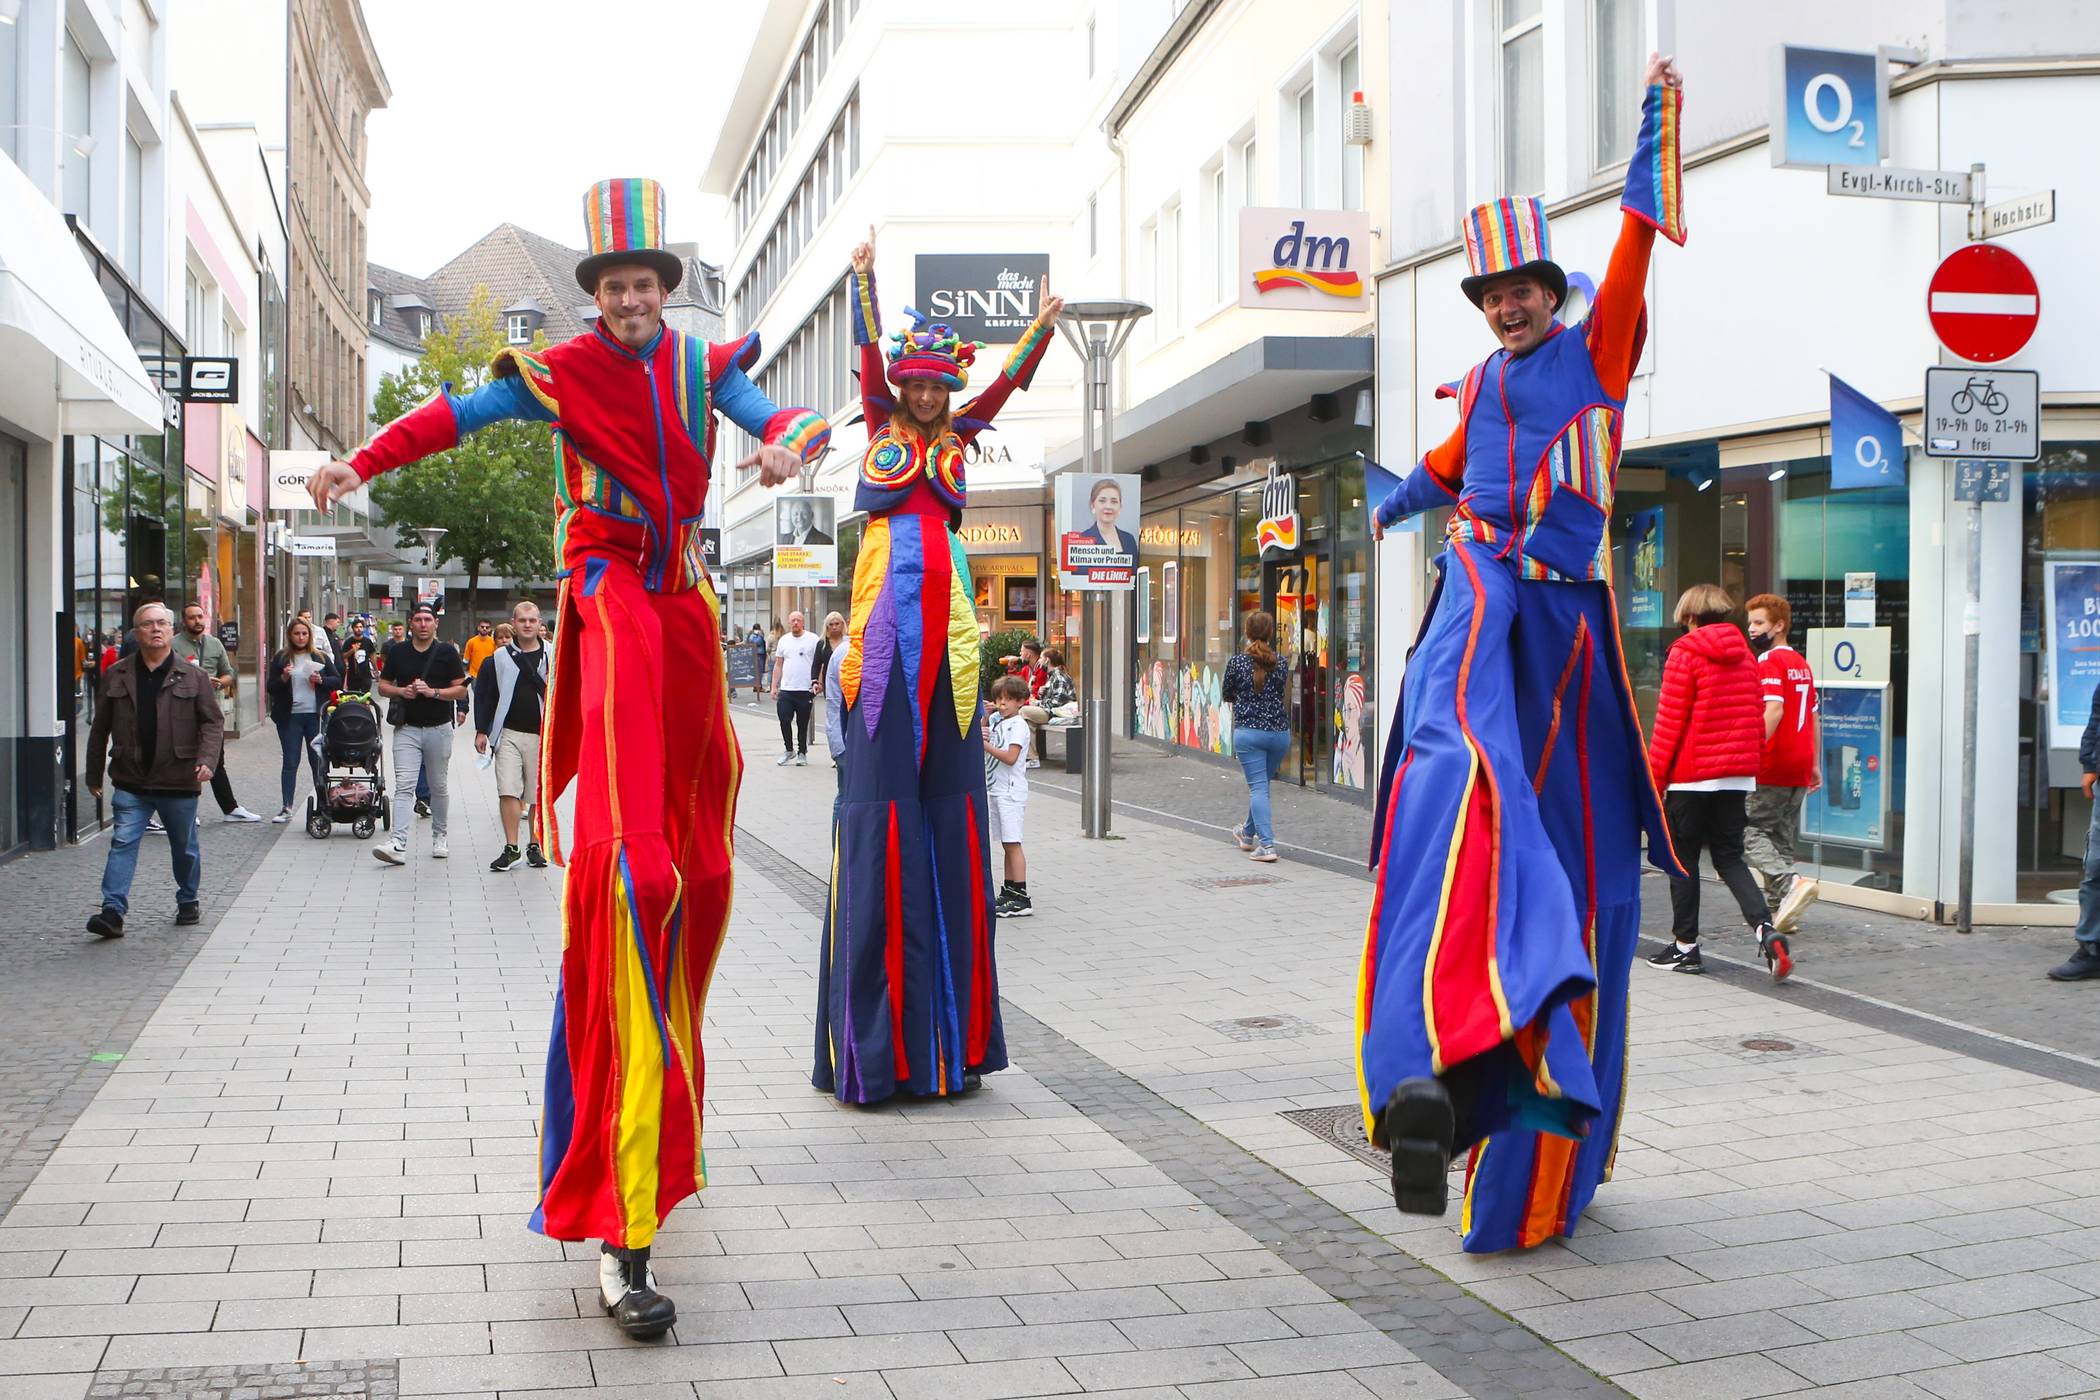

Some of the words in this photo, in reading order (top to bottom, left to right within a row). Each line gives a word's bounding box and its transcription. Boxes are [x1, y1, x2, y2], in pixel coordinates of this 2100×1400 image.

[1804, 73, 1865, 148] O2
[1841, 171, 1961, 197] Evgl.-Kirch-Str.
[1993, 202, 2047, 228] Hochstr.
[1273, 220, 1351, 269] dm
[996, 267, 1020, 281] das
[997, 276, 1035, 290] macht
[1936, 417, 1968, 432] 19-9h
[1975, 418, 1989, 433] Do
[1995, 419, 2028, 433] 21-9h
[1855, 435, 1889, 475] O2
[1972, 437, 1991, 451] frei
[1264, 464, 1293, 521] dm
[1070, 546, 1100, 555] Mensch
[1101, 546, 1115, 555] und
[1070, 555, 1092, 564] Klima
[1093, 556, 1105, 564] vor
[1105, 556, 1131, 565] Profite!
[1091, 570, 1106, 581] DIE
[1834, 641, 1862, 678] O2
[1795, 683, 1809, 732] 7
